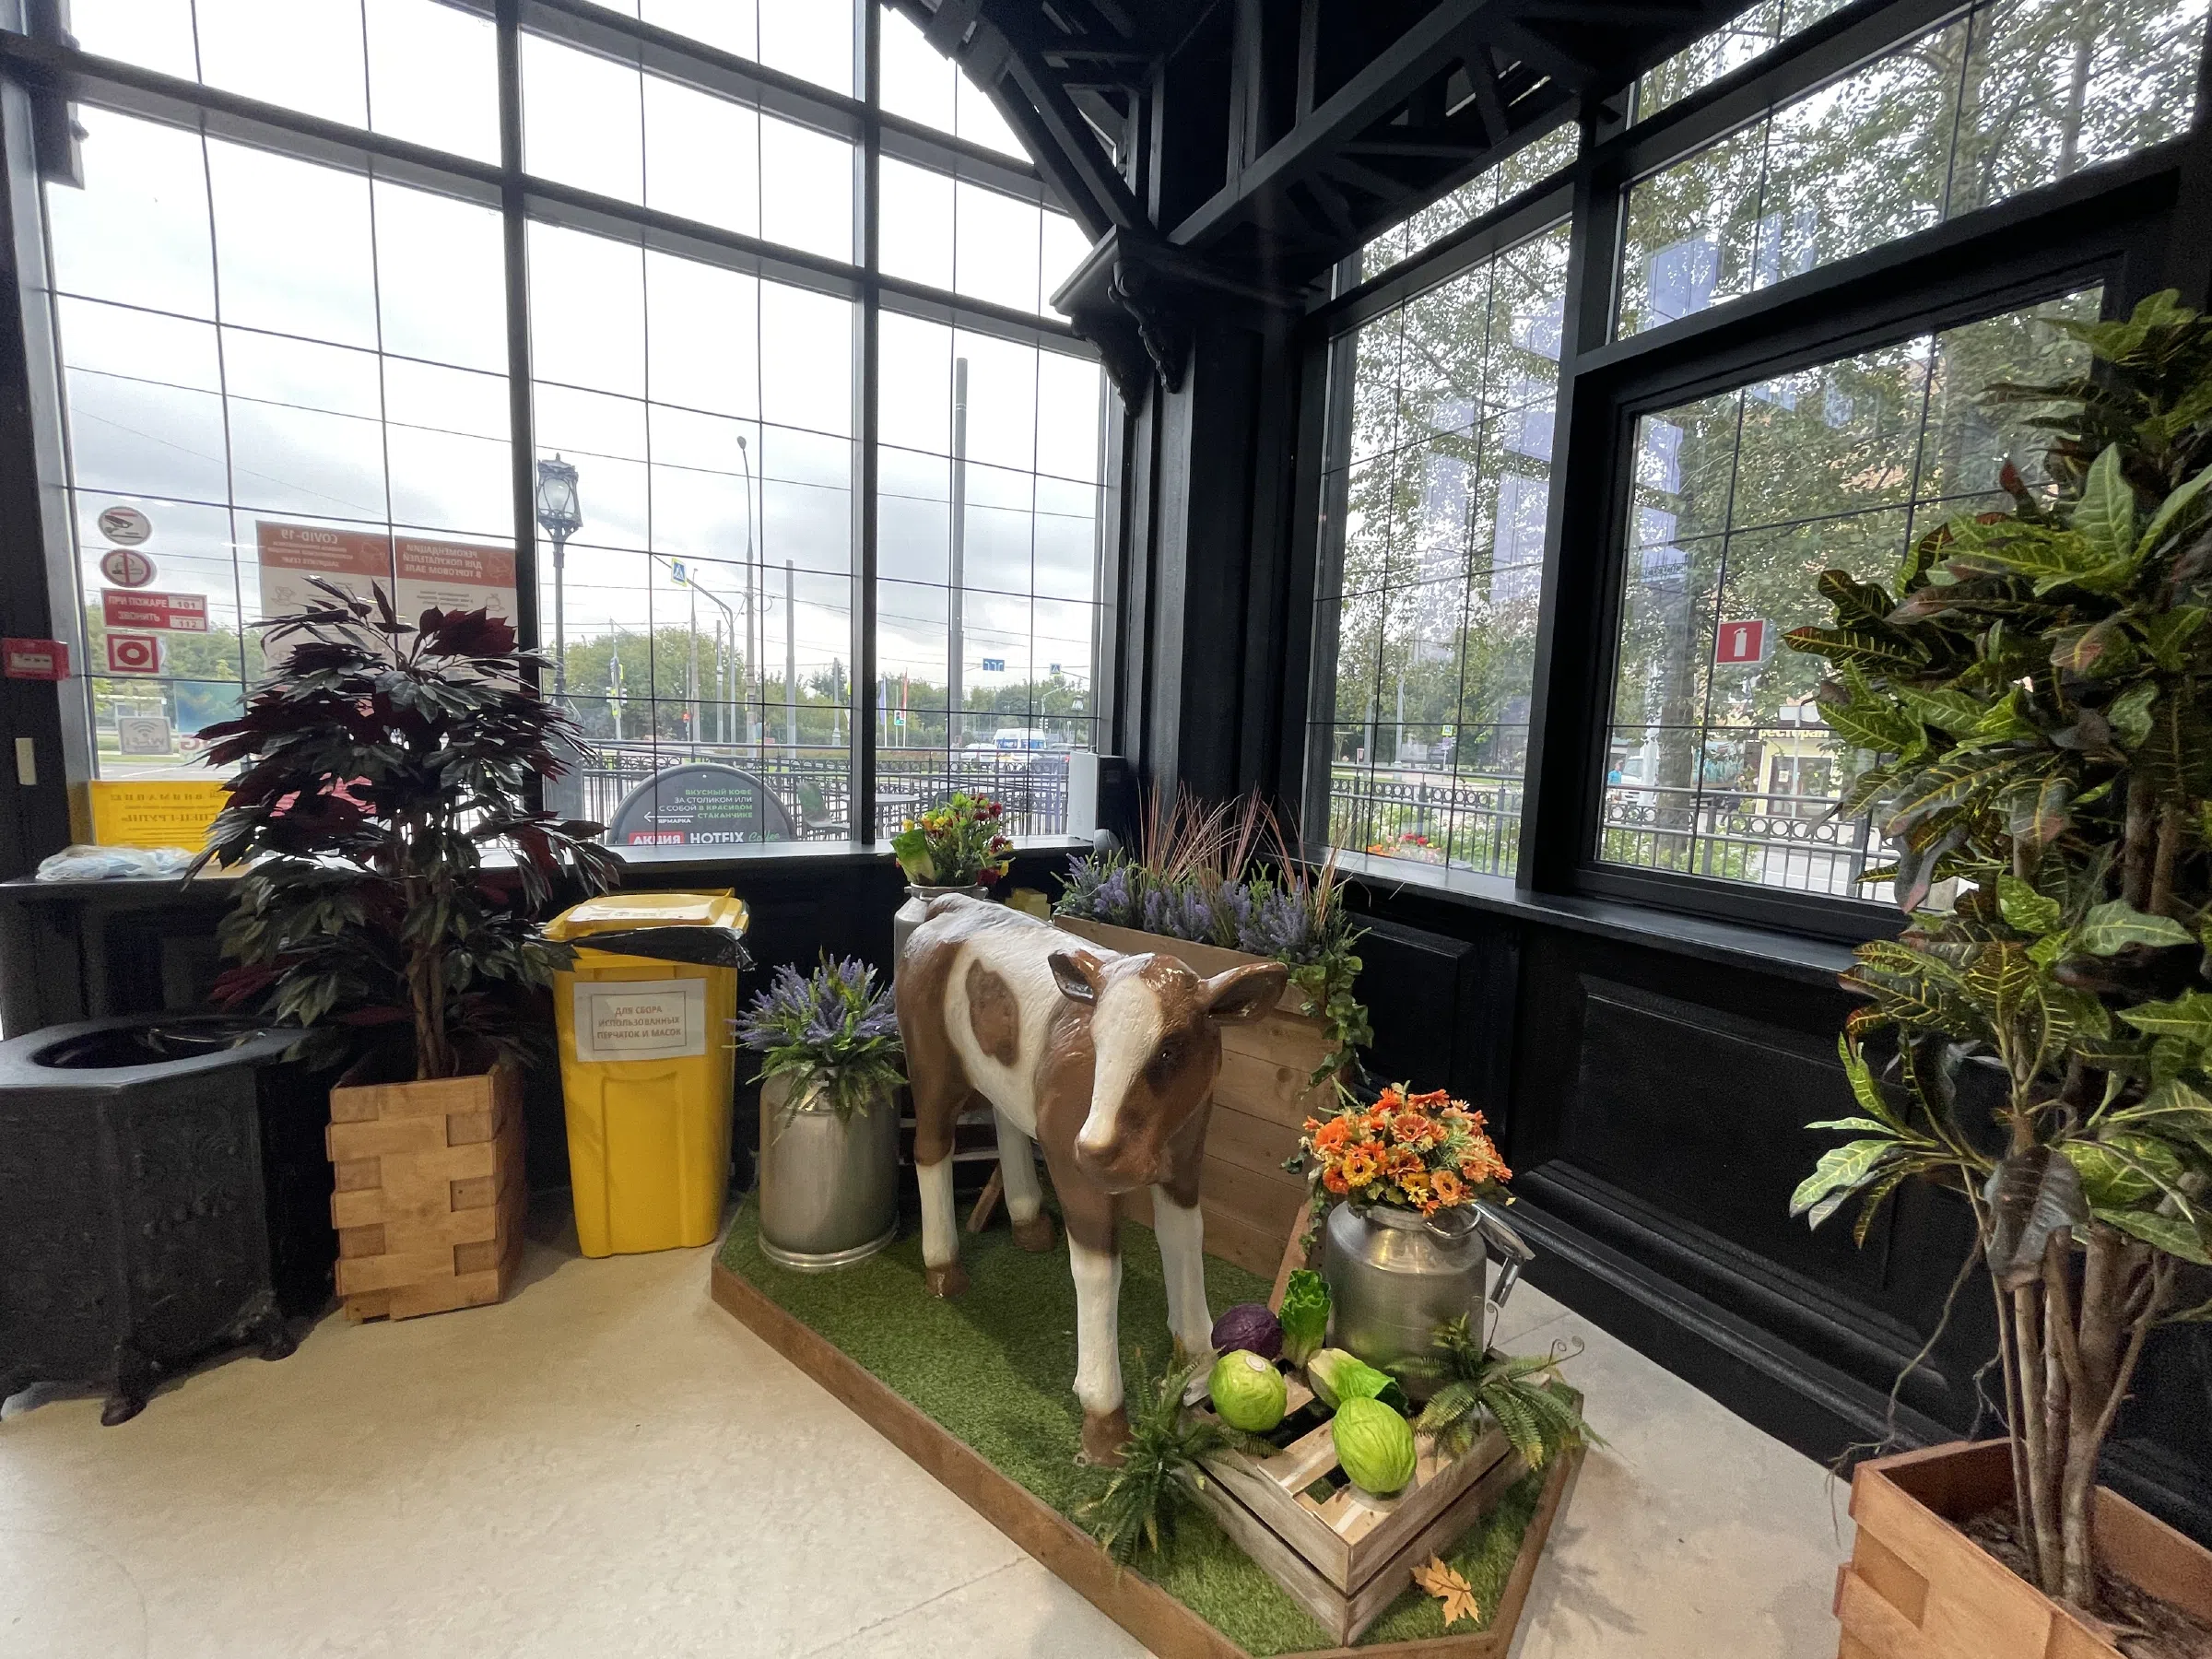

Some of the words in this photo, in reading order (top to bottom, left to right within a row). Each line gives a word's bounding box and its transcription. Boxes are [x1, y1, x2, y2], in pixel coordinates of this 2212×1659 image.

[108, 595, 127, 606] ПРИ
[128, 597, 168, 608] ПОЖАРЕ
[117, 610, 161, 622] ЗВОНИТЬ
[666, 804, 697, 812] СОБОЙ
[697, 811, 753, 819] СТАКАНЧИКЕ
[633, 834, 681, 845] АКЦИЯ
[689, 831, 745, 843] HOTFIX
[615, 1006, 633, 1017] ДЛЯ
[635, 1005, 663, 1014] СБОРА
[598, 1016, 680, 1028] ИСПОЛЬЗОВАННЫХ
[597, 1030, 640, 1040] ПЕРЧАТОК
[641, 1030, 649, 1038] И
[651, 1028, 682, 1038] МАСОК
